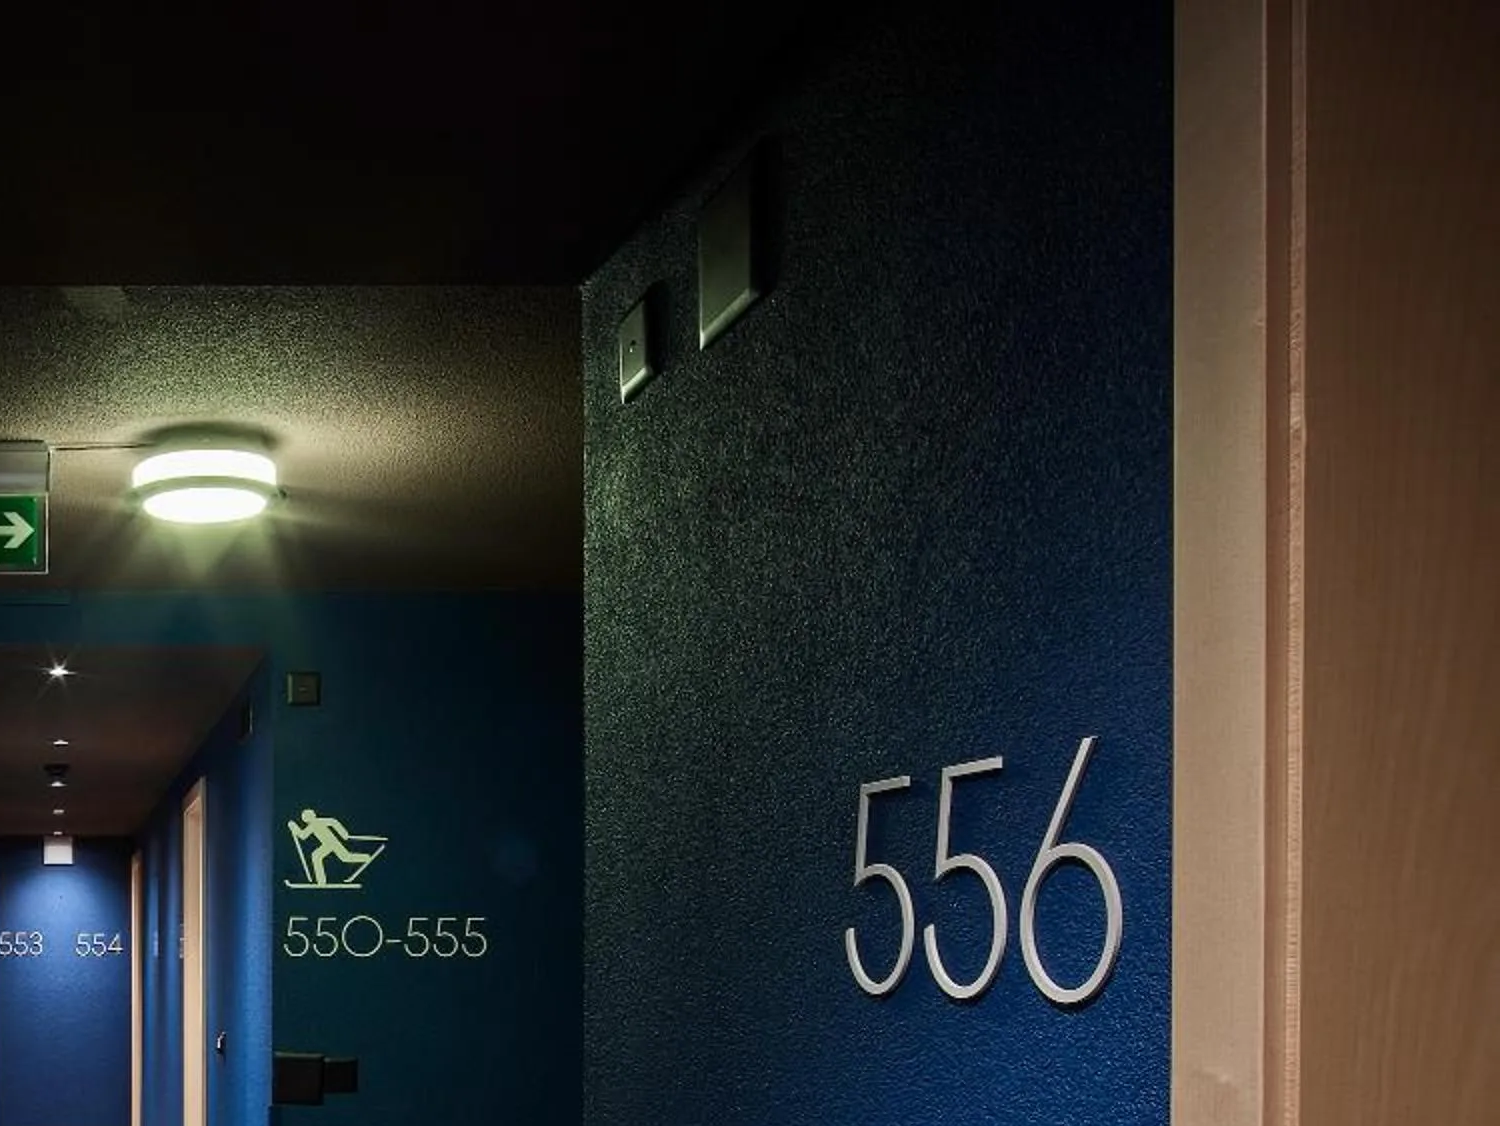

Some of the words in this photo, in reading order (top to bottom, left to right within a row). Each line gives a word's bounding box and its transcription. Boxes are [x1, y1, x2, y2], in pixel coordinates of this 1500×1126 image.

[846, 736, 1123, 1003] 556
[75, 933, 123, 957] 554
[283, 915, 488, 957] 550-555
